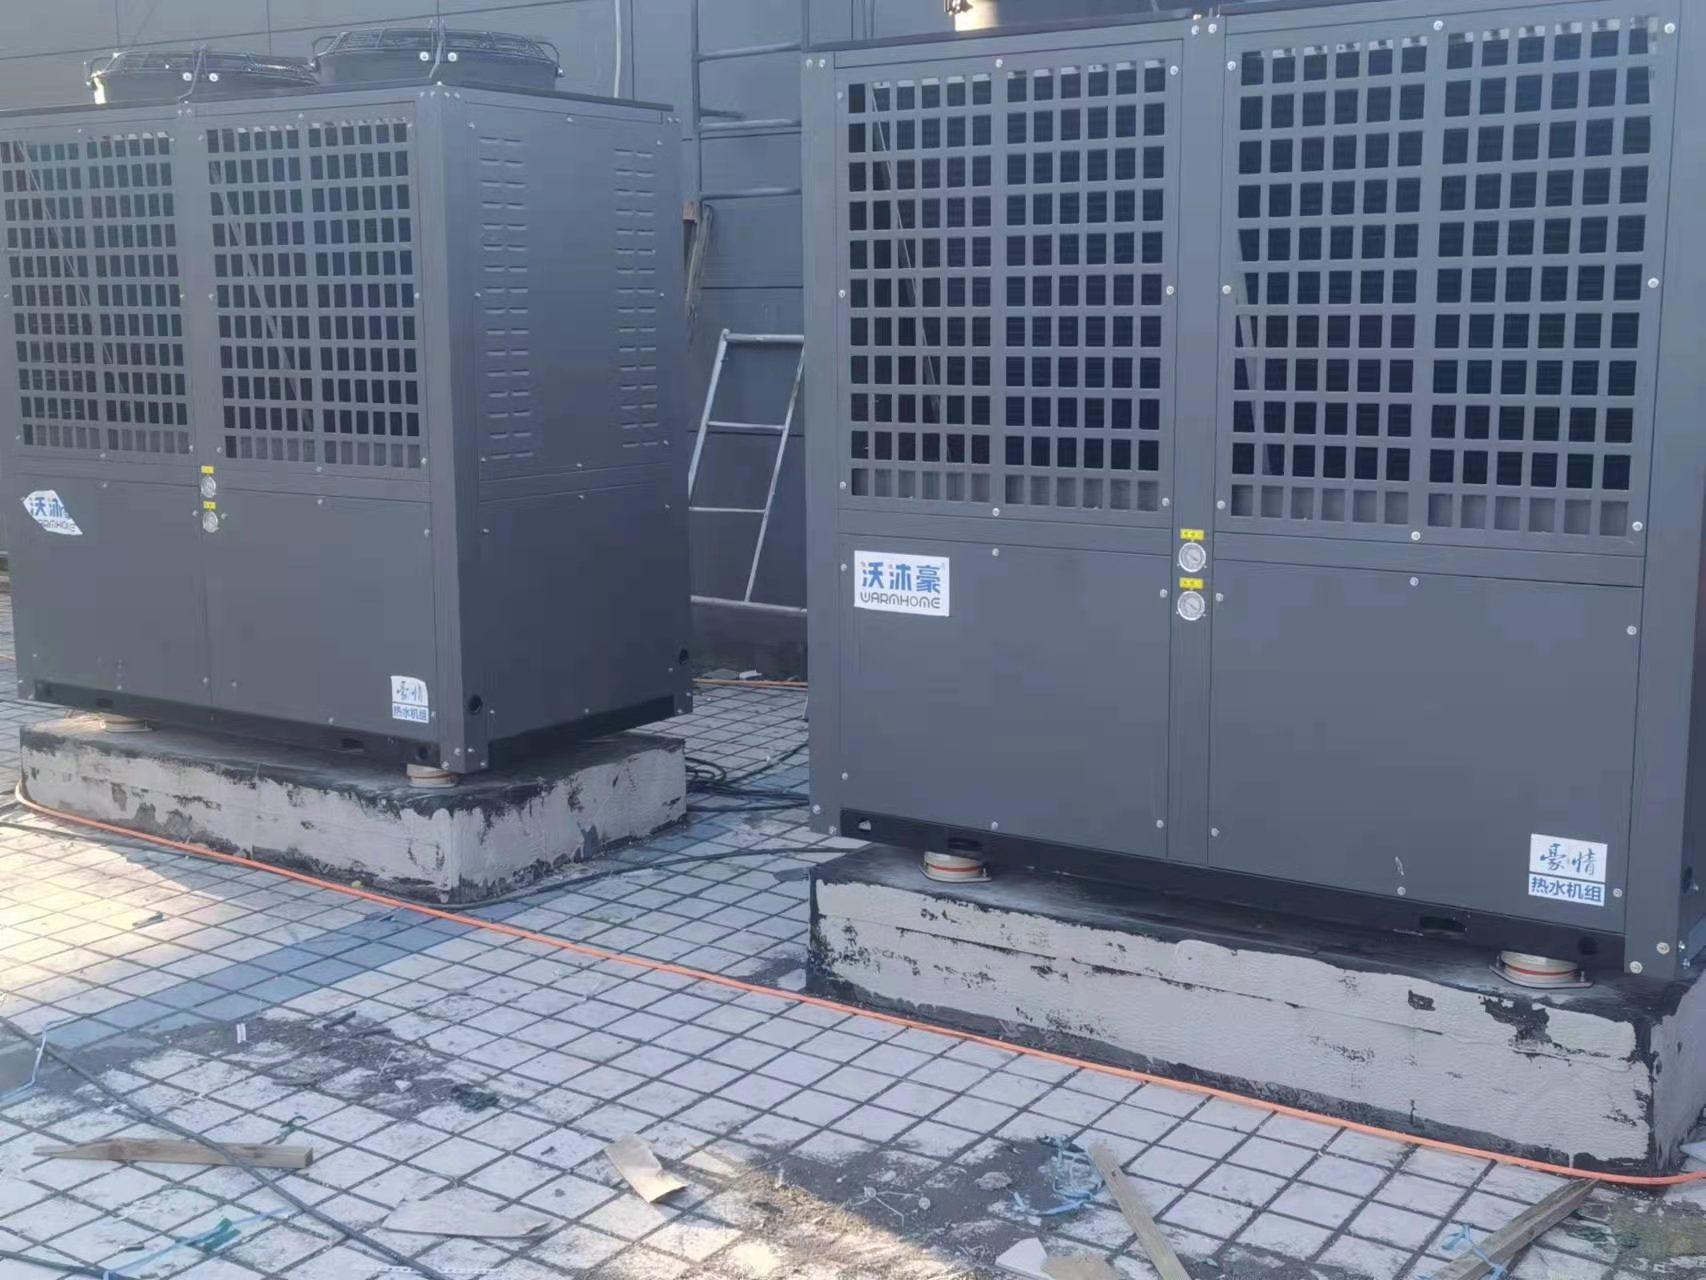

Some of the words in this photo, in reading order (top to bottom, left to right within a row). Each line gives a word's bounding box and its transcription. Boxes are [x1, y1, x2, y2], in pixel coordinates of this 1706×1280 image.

[861, 561, 941, 594] 沃沐豪
[860, 592, 941, 609] WARMHOME
[1540, 843, 1597, 876] 豪情
[1531, 876, 1602, 903] 热水机组
